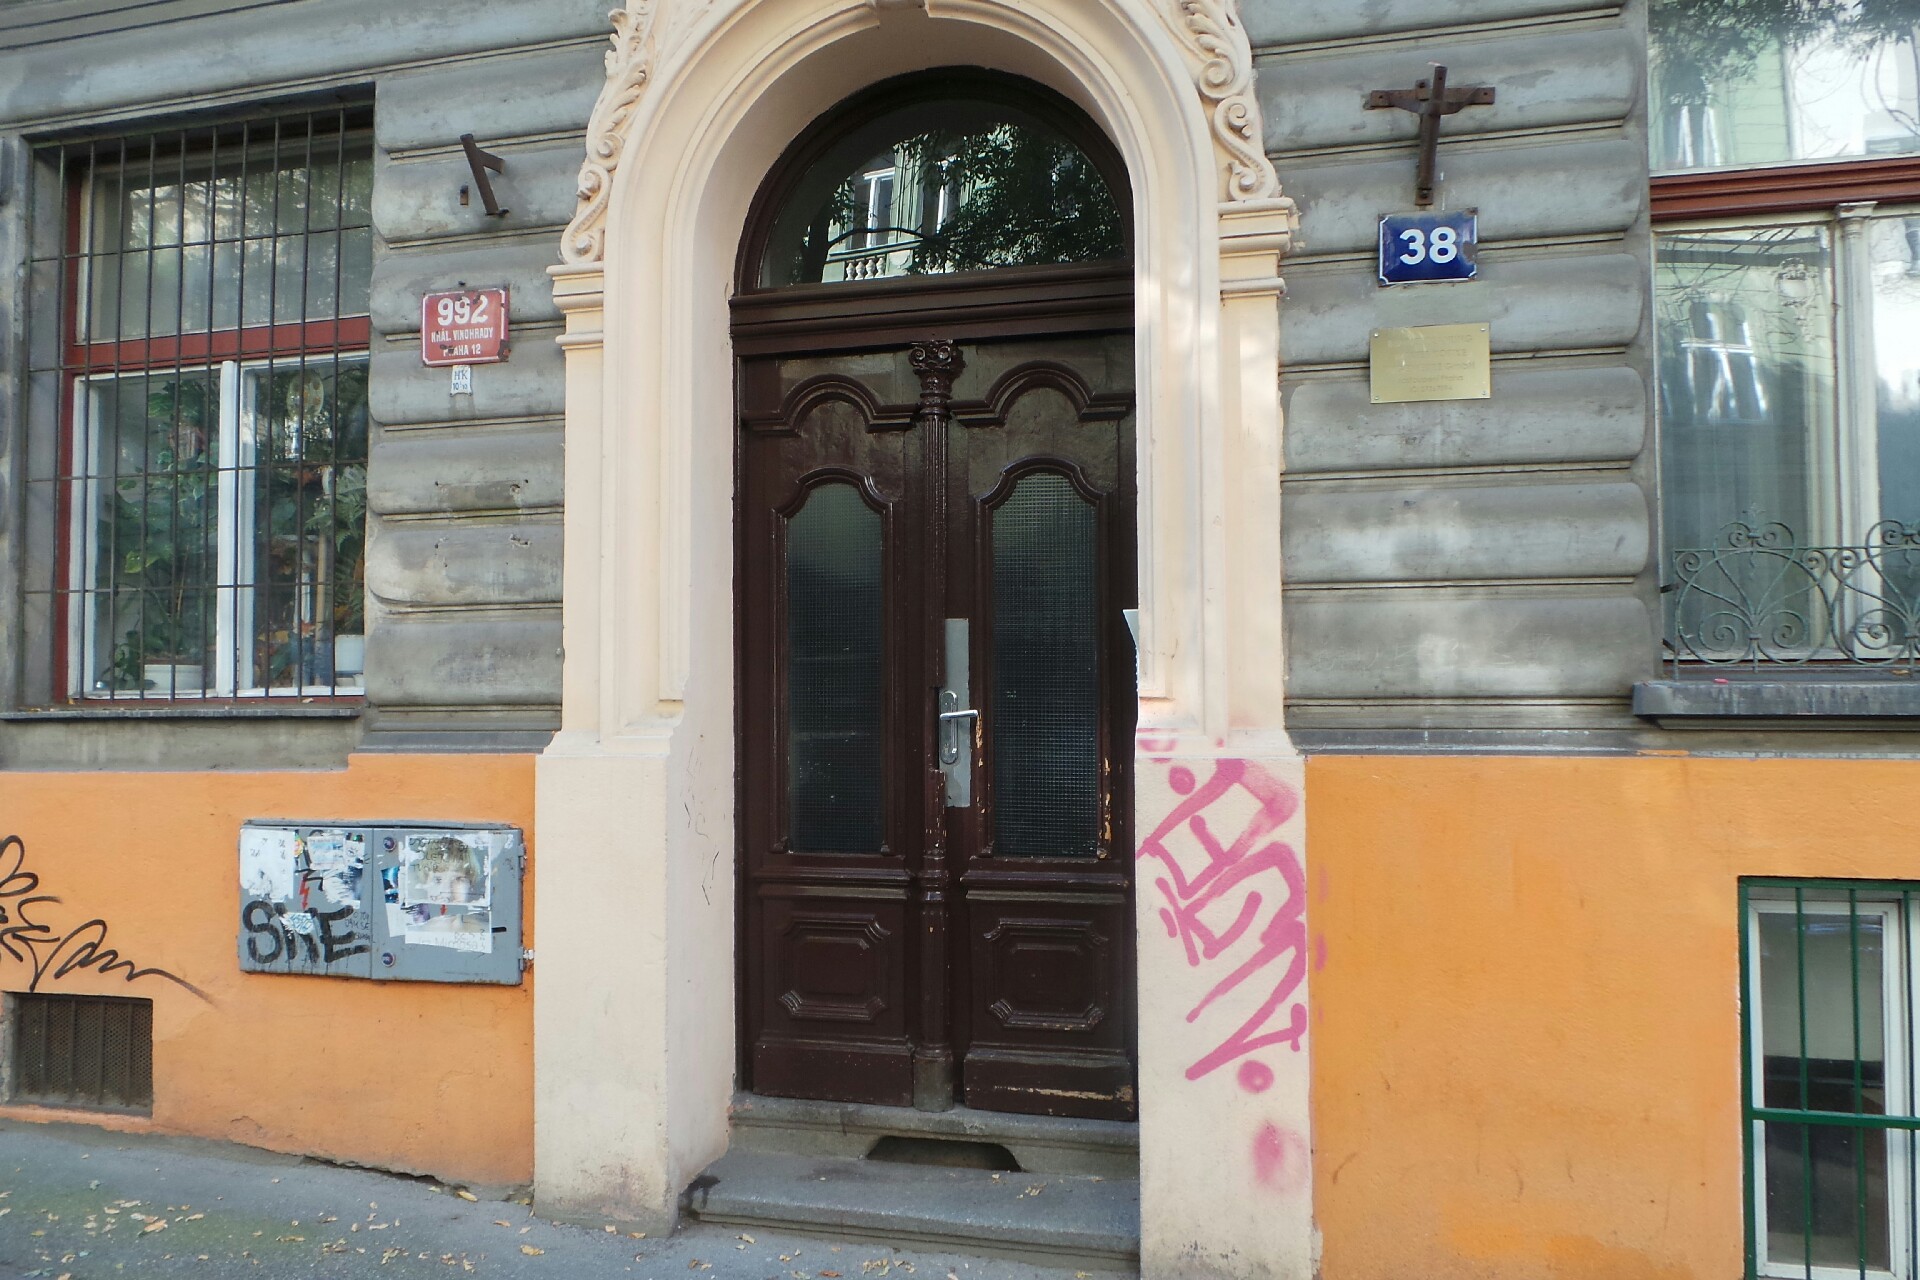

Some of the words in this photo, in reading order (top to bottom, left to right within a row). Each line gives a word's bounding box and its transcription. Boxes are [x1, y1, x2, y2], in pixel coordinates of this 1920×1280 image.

[1400, 226, 1458, 264] 38
[437, 294, 489, 326] 992
[453, 327, 494, 341] VINOHRADY
[471, 343, 482, 355] 12
[454, 369, 468, 381] HK
